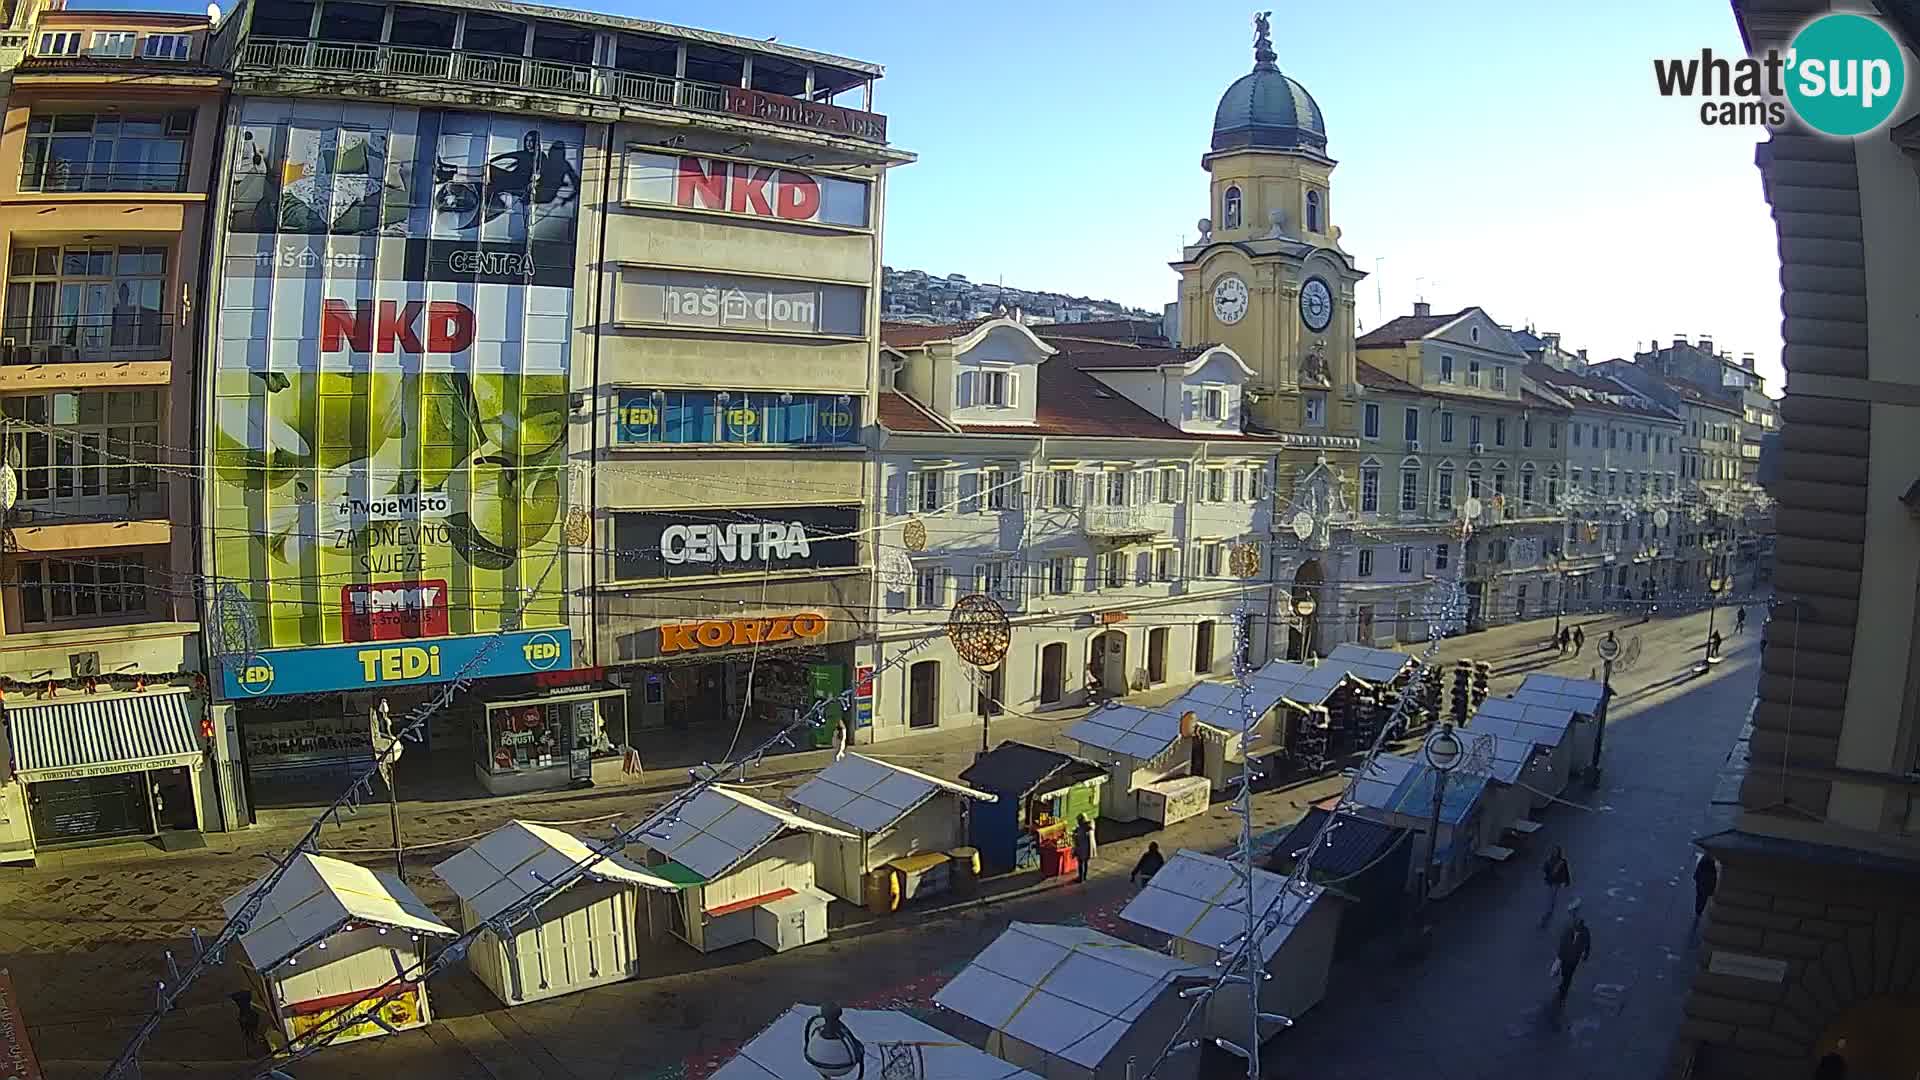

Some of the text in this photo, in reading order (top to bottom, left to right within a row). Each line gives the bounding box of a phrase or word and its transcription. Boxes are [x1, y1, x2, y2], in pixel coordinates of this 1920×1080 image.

[677, 157, 821, 221] NKD
[449, 250, 536, 276] CENTRA
[668, 284, 815, 326] naš dom
[321, 297, 477, 354] NKD
[339, 497, 447, 516] #TvojeMisto
[333, 522, 452, 549] ZA DNEVNO
[660, 521, 811, 565] CENTRA
[359, 546, 427, 575] SVJEŽE
[350, 587, 441, 615] TOMMY
[659, 612, 827, 656] KORZO
[358, 645, 441, 683] TEDi
[523, 643, 560, 660] TEDi
[41, 759, 178, 781] TURISTIČKI INFORMATIVNI CENTAR
